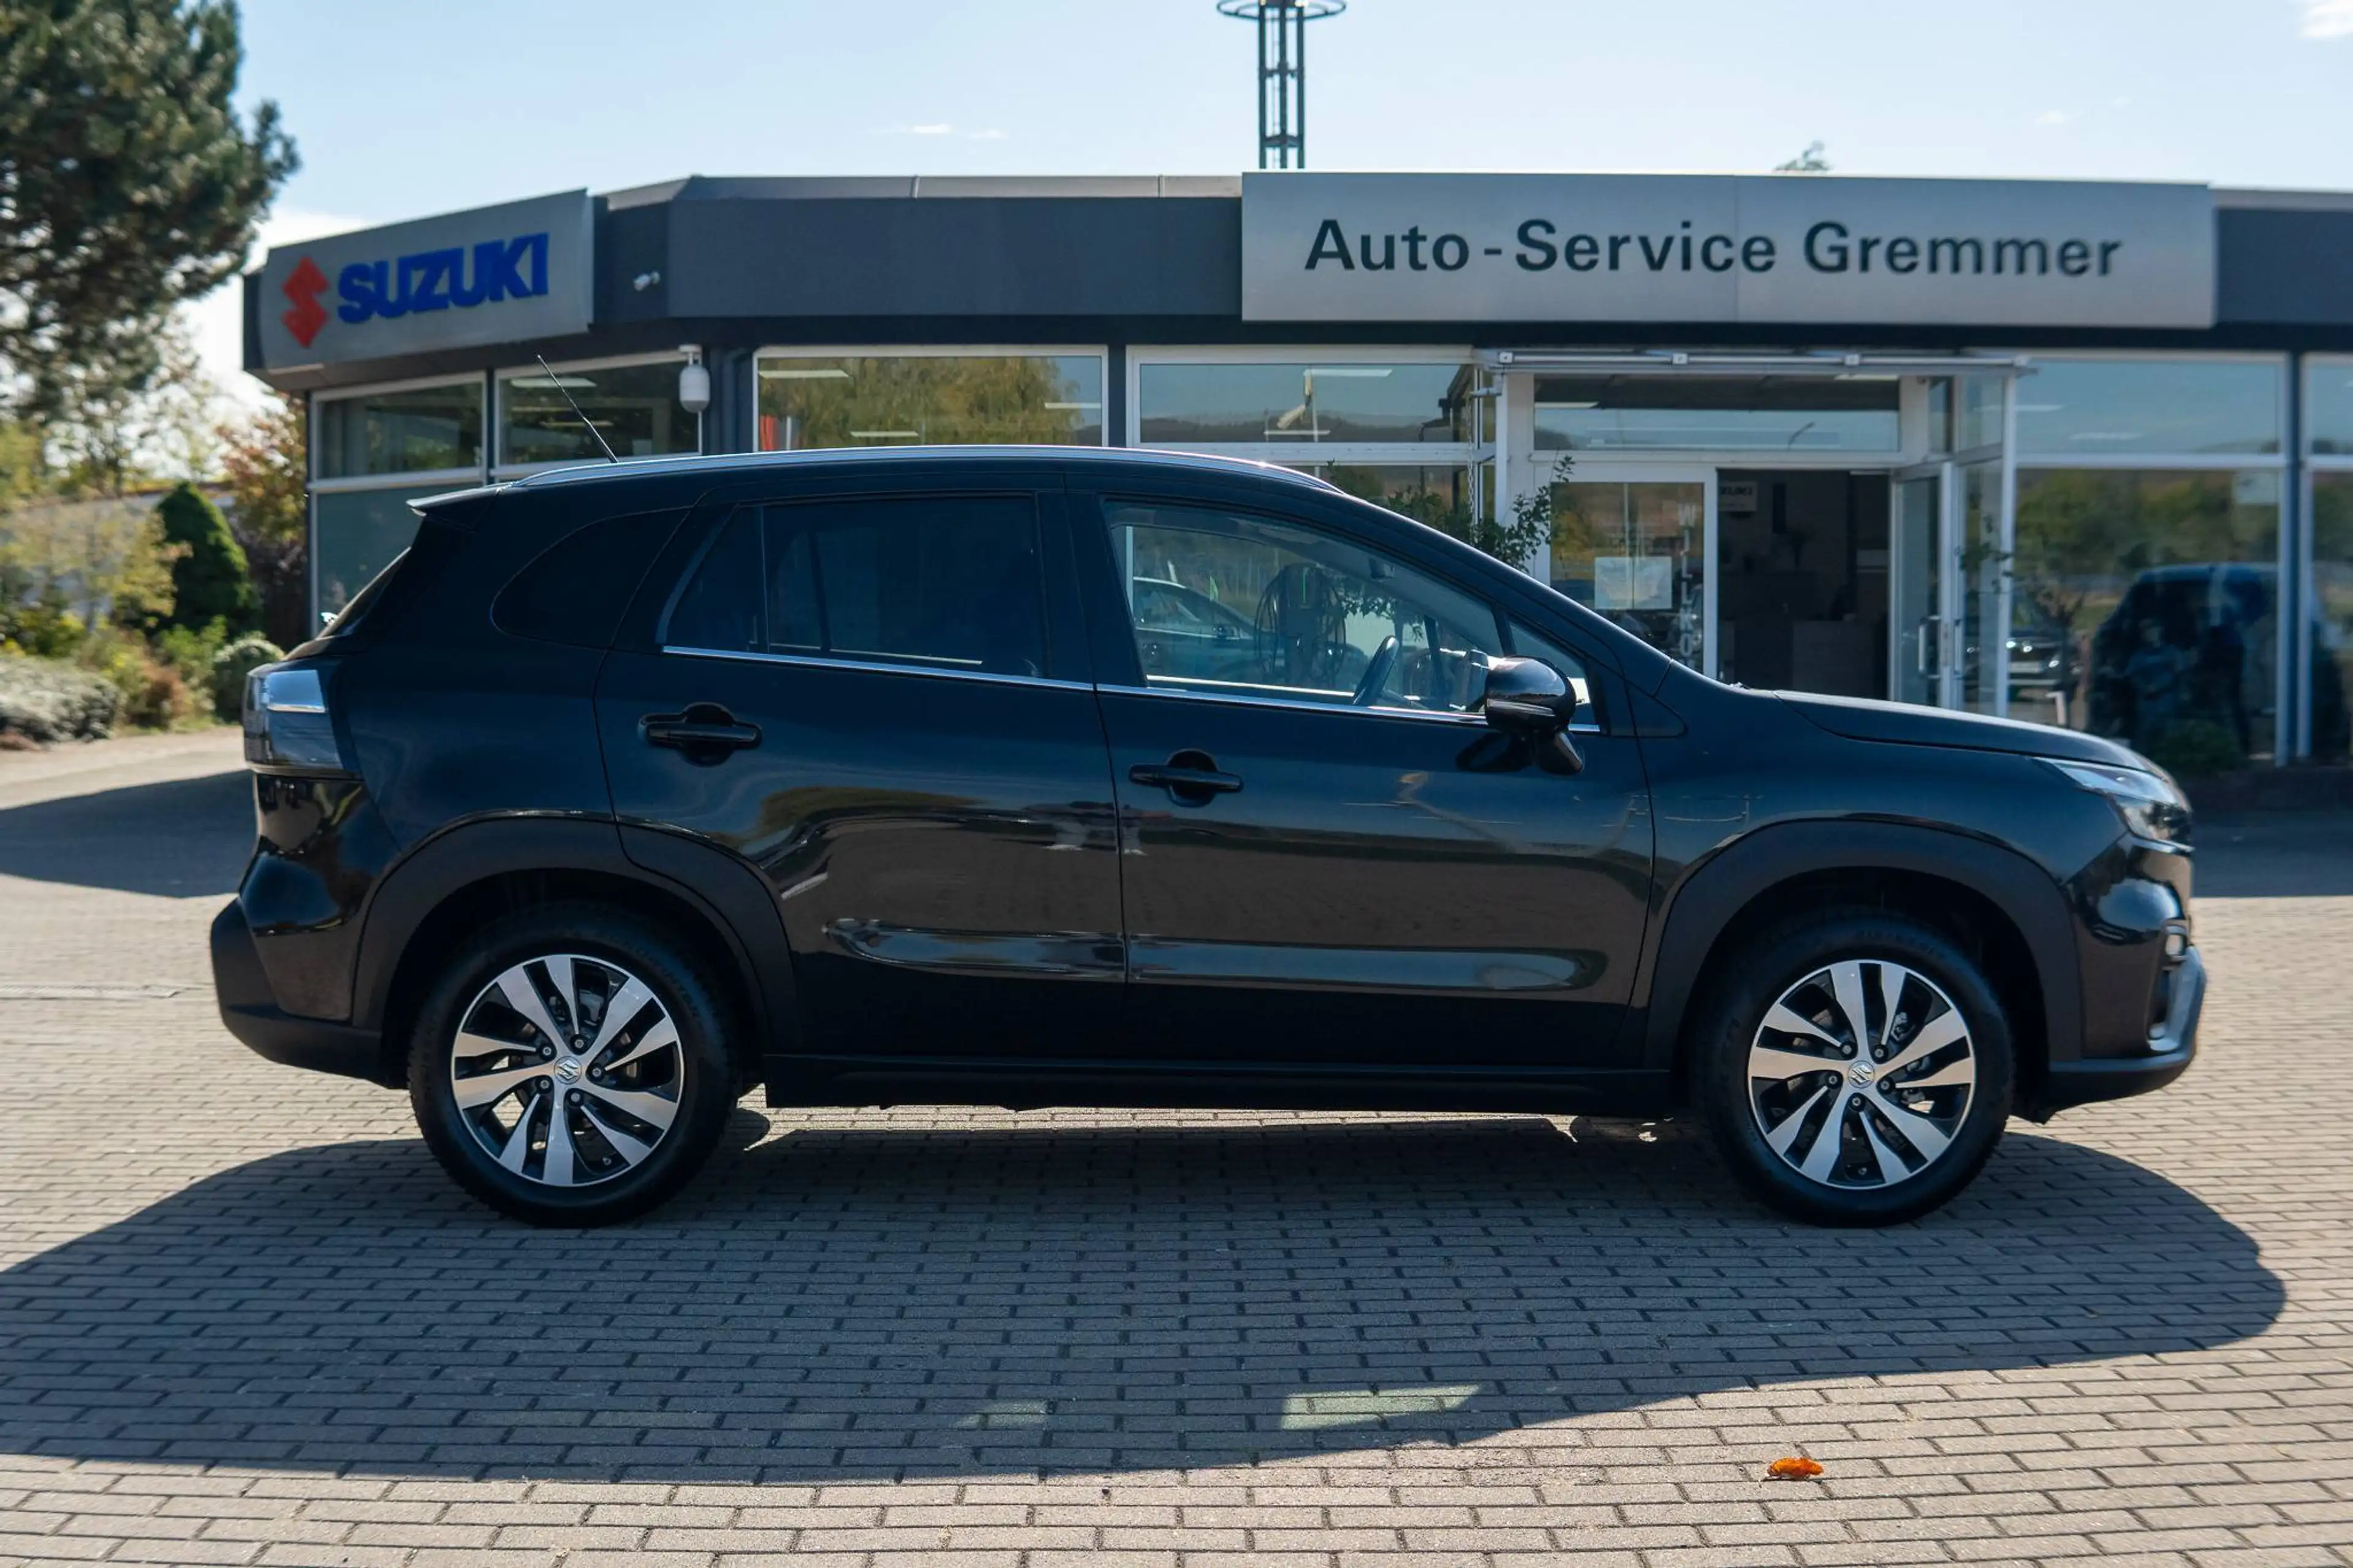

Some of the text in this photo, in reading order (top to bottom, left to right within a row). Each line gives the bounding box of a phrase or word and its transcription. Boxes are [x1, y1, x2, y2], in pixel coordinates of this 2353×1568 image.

[338, 232, 550, 324] SUZUKI
[1305, 219, 2121, 276] Auto-Service Gremmer
